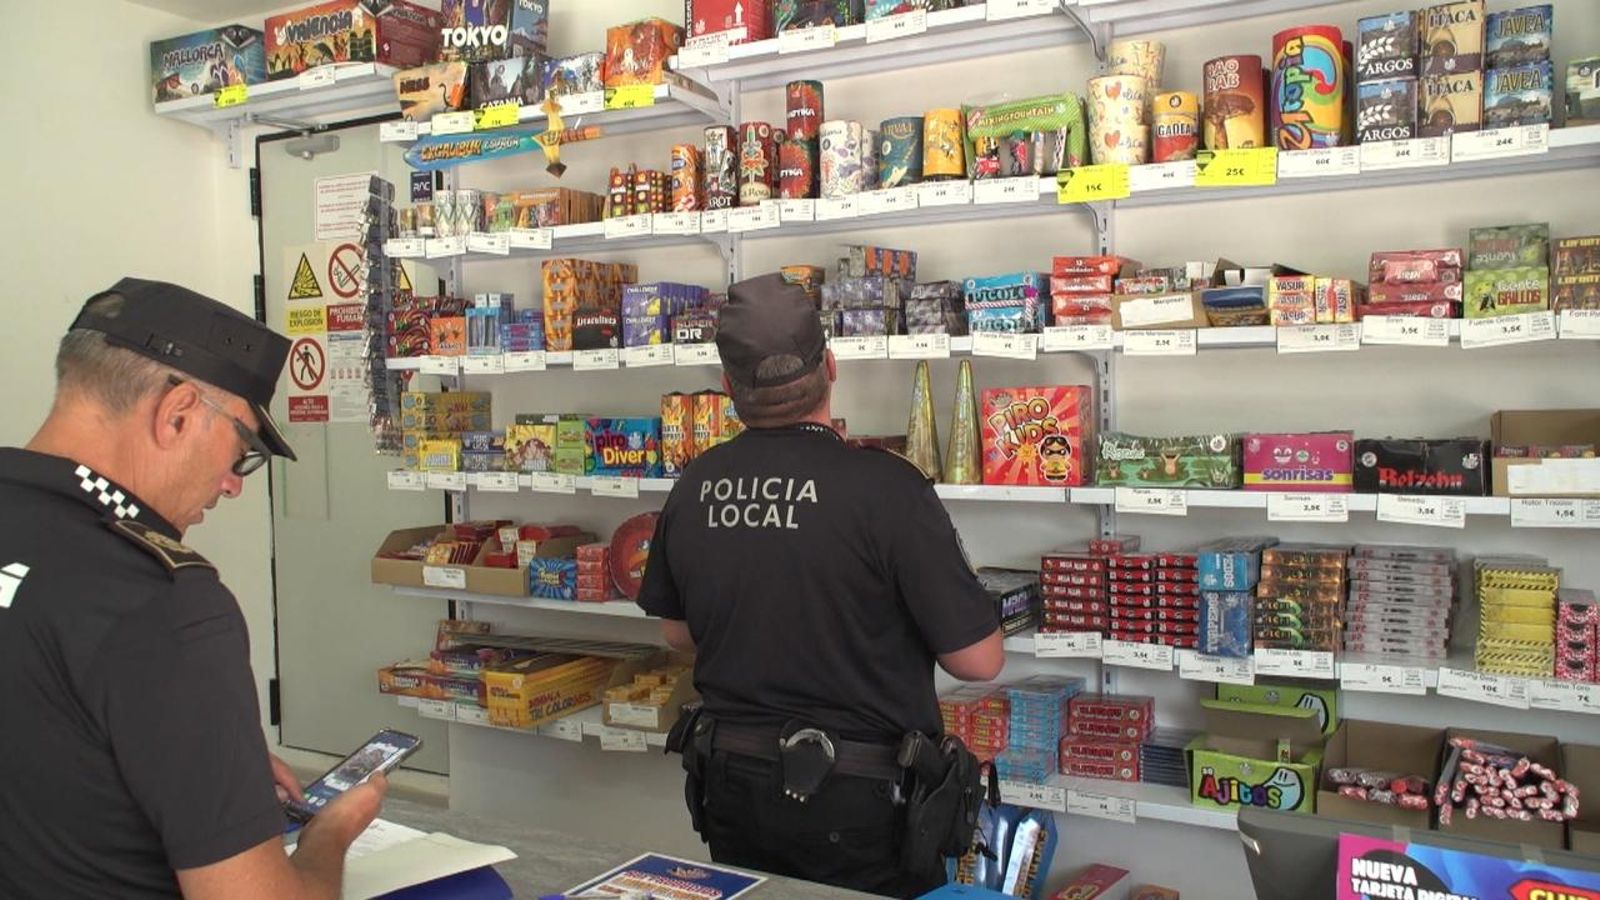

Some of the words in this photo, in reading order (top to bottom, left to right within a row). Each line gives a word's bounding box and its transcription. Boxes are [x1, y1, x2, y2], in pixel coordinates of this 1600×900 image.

[441, 23, 508, 48] TOKYO
[163, 42, 225, 68] MALLORCA
[1365, 57, 1414, 75] ARGOS
[1158, 124, 1192, 136] GADEA
[1362, 127, 1411, 141] ARGOS
[1496, 137, 1513, 146] 24€
[1225, 168, 1245, 177] 25€
[1085, 183, 1102, 193] 15€
[1276, 282, 1305, 291] VASUR
[1401, 326, 1418, 334] 3,5€
[1502, 325, 1521, 333] 3,5€
[988, 398, 1050, 437] PIRO
[595, 427, 627, 455] piro
[995, 415, 1059, 460] KIDS
[603, 448, 645, 465] Diver
[1262, 466, 1334, 481] sonrisas
[700, 477, 818, 503] POLICIA
[708, 504, 799, 529] LOCAL
[1481, 684, 1497, 692] 10€
[1577, 694, 1589, 702] 7€
[1351, 858, 1418, 885] NUEVA
[1351, 878, 1413, 900] TARJETA
[1418, 887, 1479, 900] DIGIT
